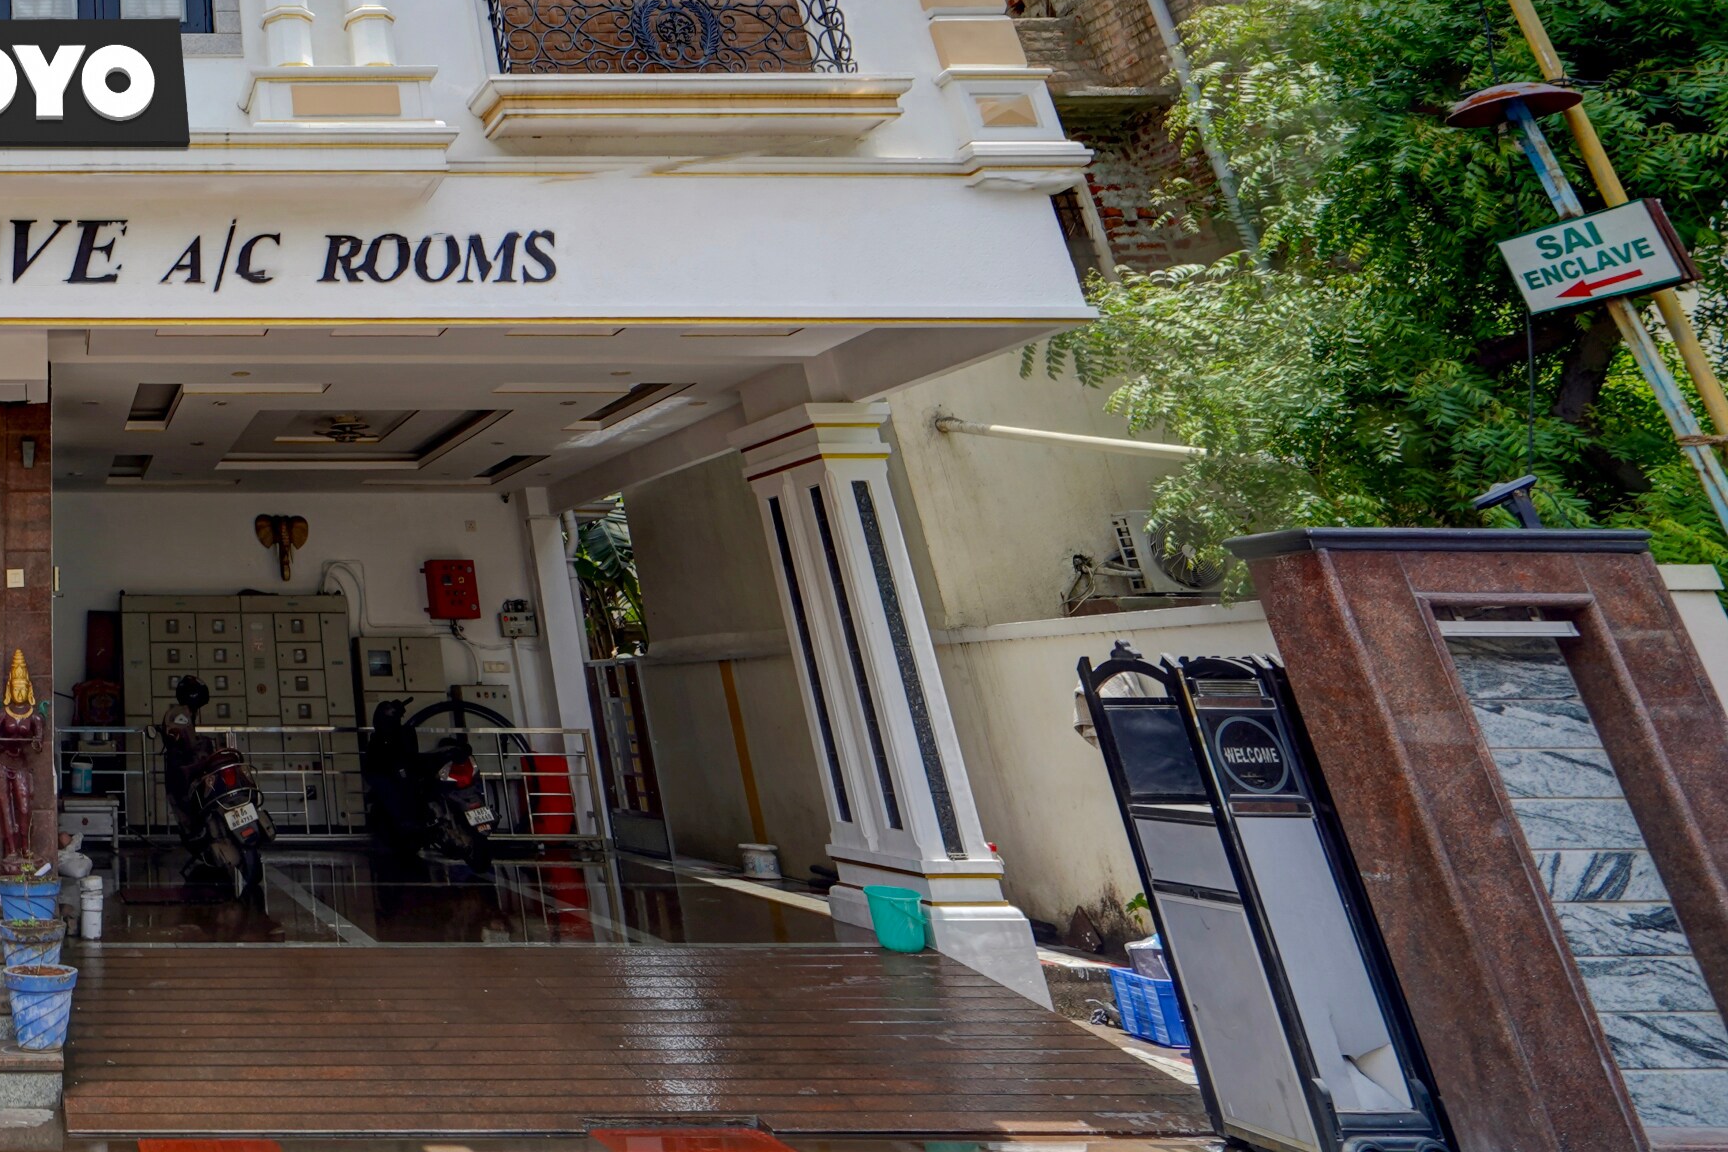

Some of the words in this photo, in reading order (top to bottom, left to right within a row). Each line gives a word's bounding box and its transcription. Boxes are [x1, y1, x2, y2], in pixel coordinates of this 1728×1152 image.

[160, 218, 281, 293] A/C
[316, 230, 557, 284] ROOMS
[1535, 220, 1604, 260] SAI
[1523, 237, 1656, 290] ENCLAVE
[1223, 747, 1279, 764] WELCOME
